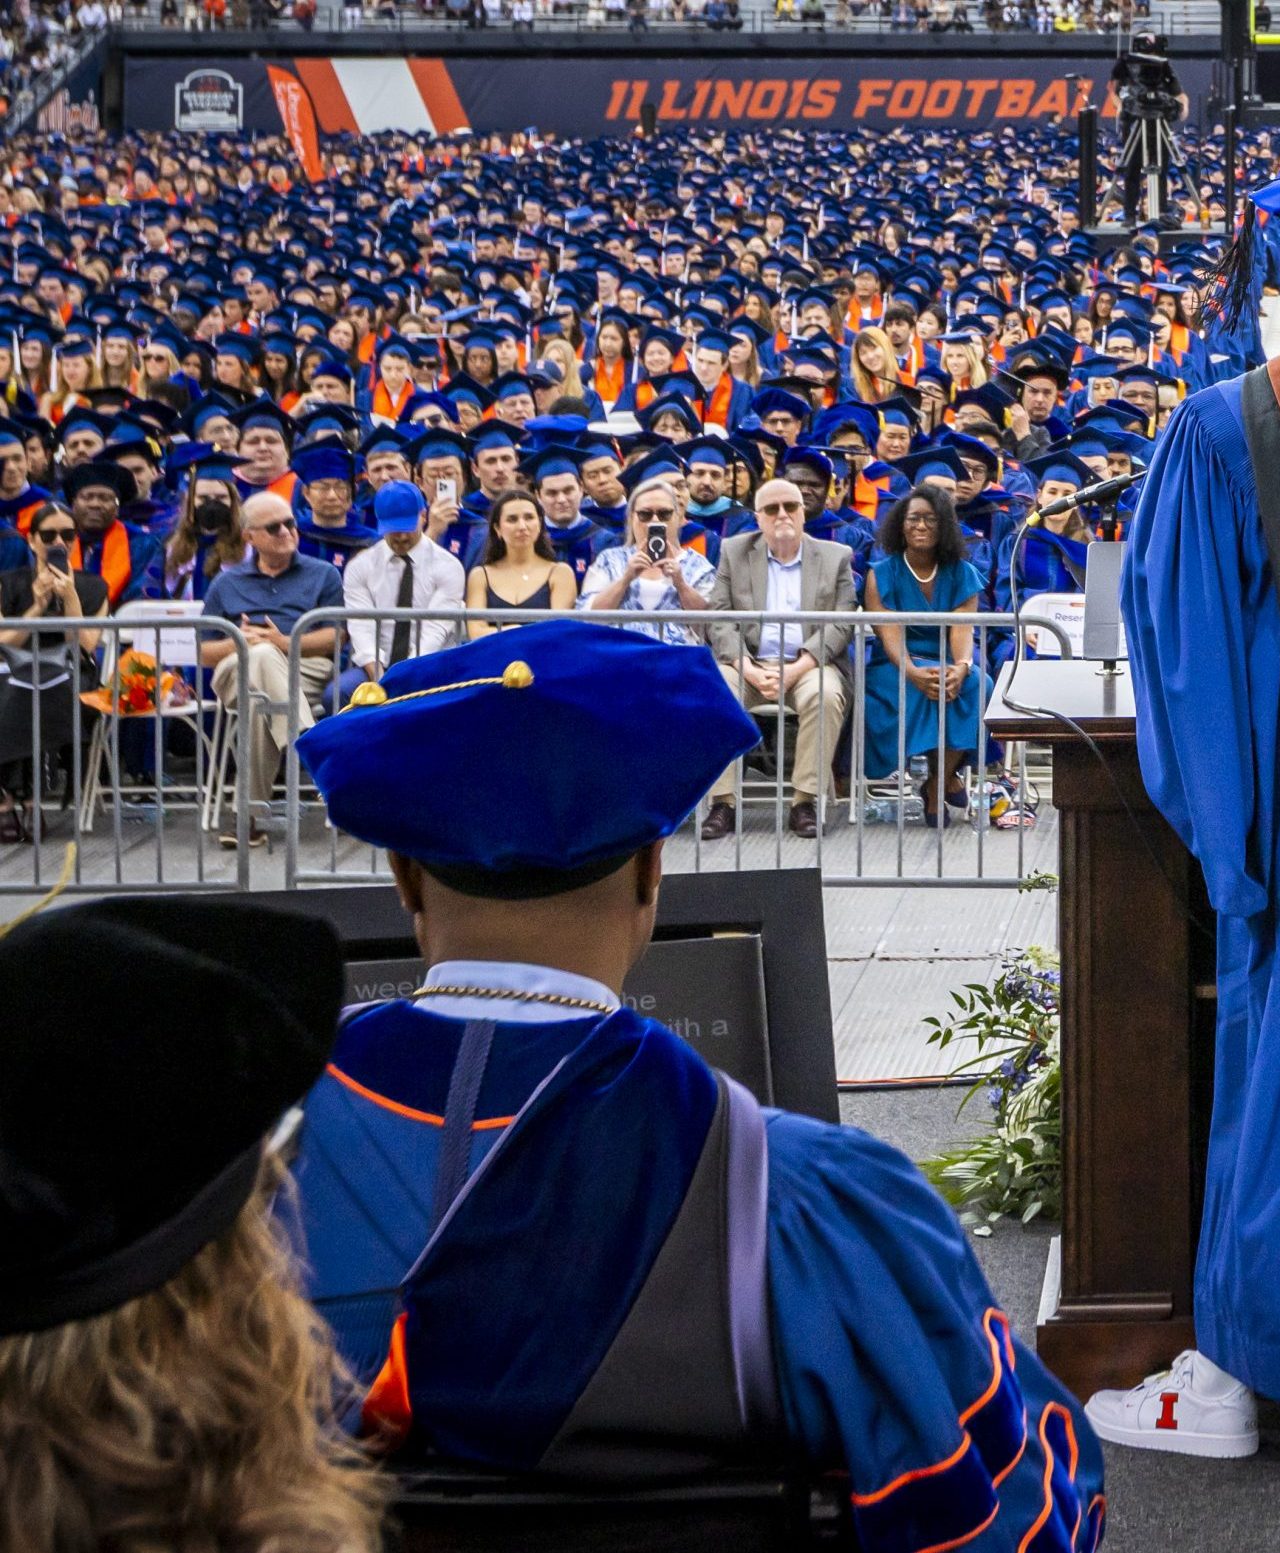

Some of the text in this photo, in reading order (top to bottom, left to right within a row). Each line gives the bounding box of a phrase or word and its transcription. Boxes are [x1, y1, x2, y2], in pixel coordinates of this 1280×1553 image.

[606, 79, 842, 120] ILLINOIS
[1055, 612, 1084, 622] Reser
[621, 992, 656, 1011] he
[667, 1017, 729, 1037] ith a
[1155, 1392, 1179, 1430] I
